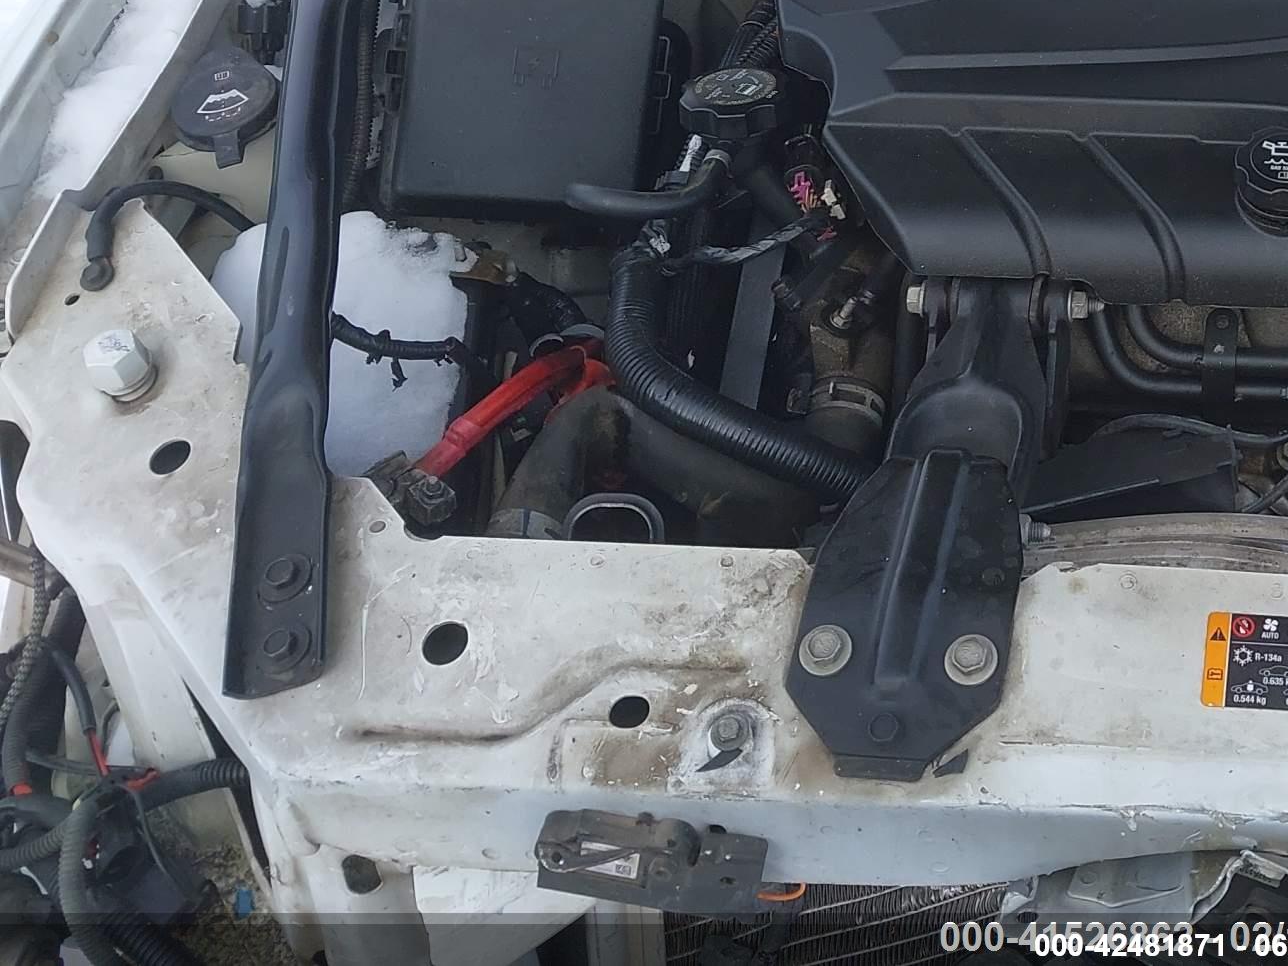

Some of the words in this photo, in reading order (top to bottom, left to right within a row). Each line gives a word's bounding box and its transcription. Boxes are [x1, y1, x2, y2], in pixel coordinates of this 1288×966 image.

[1261, 632, 1279, 640] AUTO
[1254, 652, 1282, 662] R-134a
[1263, 677, 1284, 686] 0.635
[1233, 694, 1255, 703] 0.544
[1256, 695, 1267, 705] kg
